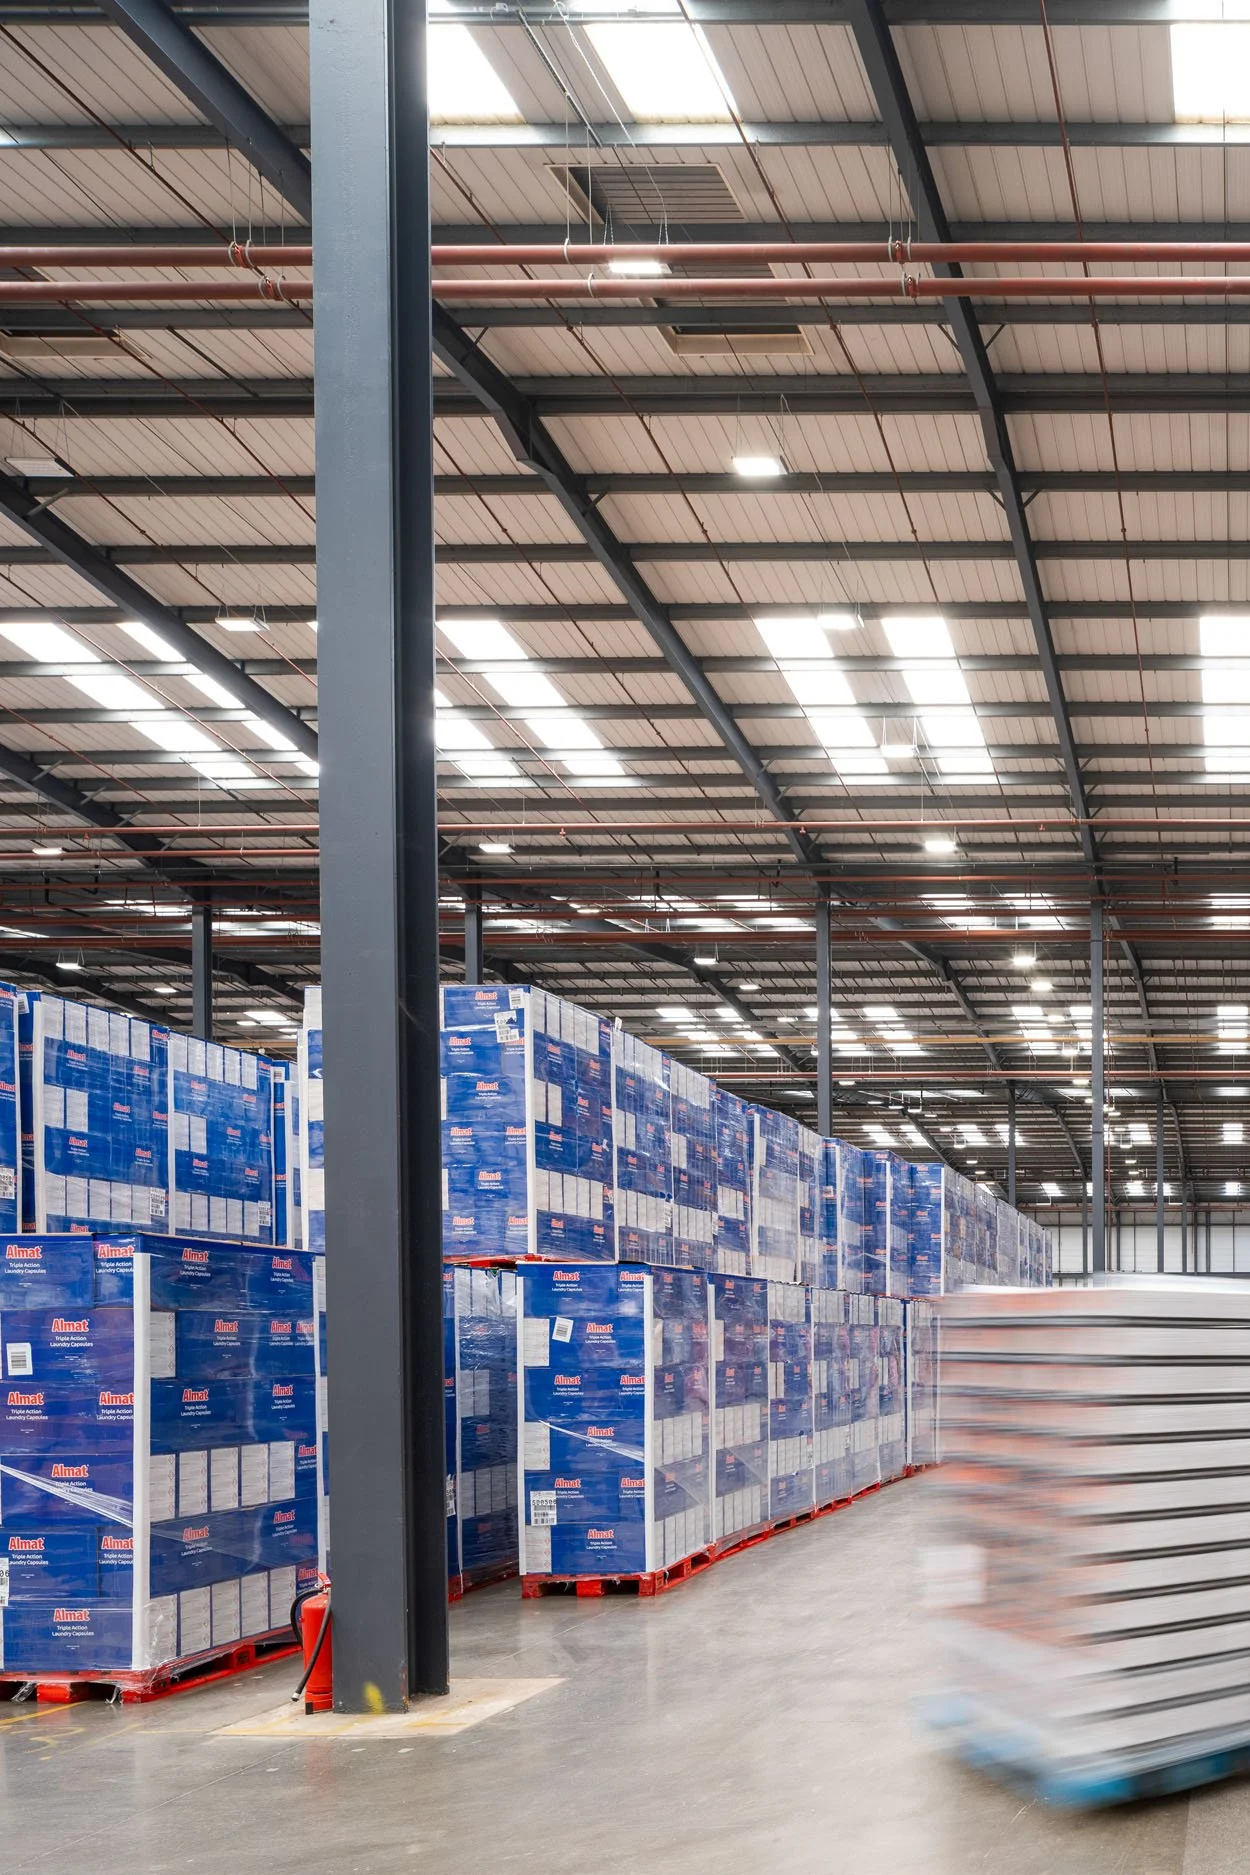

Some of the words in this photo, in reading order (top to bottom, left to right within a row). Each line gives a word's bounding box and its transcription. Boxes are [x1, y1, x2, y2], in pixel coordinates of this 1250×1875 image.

[6, 1245, 42, 1259] Almat
[98, 1245, 134, 1258] Almat
[182, 1248, 208, 1262] Almat
[272, 1256, 292, 1269] Almat
[553, 1271, 580, 1281] Almat
[620, 1271, 645, 1281] Almat
[52, 1319, 88, 1332] Almat
[215, 1320, 238, 1332] Almat
[271, 1321, 292, 1333] Almat
[586, 1323, 612, 1333] Almat
[554, 1375, 581, 1385] Almat
[620, 1375, 645, 1384] Almat
[182, 1389, 209, 1402] Almat
[273, 1384, 293, 1396] Almat
[8, 1392, 44, 1406] Almat
[100, 1392, 134, 1406] Almat
[587, 1426, 614, 1436] Almat
[52, 1464, 88, 1478] Almat
[554, 1478, 581, 1488] Almat
[274, 1510, 295, 1524] Almat
[183, 1526, 209, 1540] Almat
[587, 1529, 614, 1539] Almat
[8, 1537, 44, 1550] Almat
[102, 1536, 134, 1550] Almat
[54, 1609, 90, 1622] Almat
